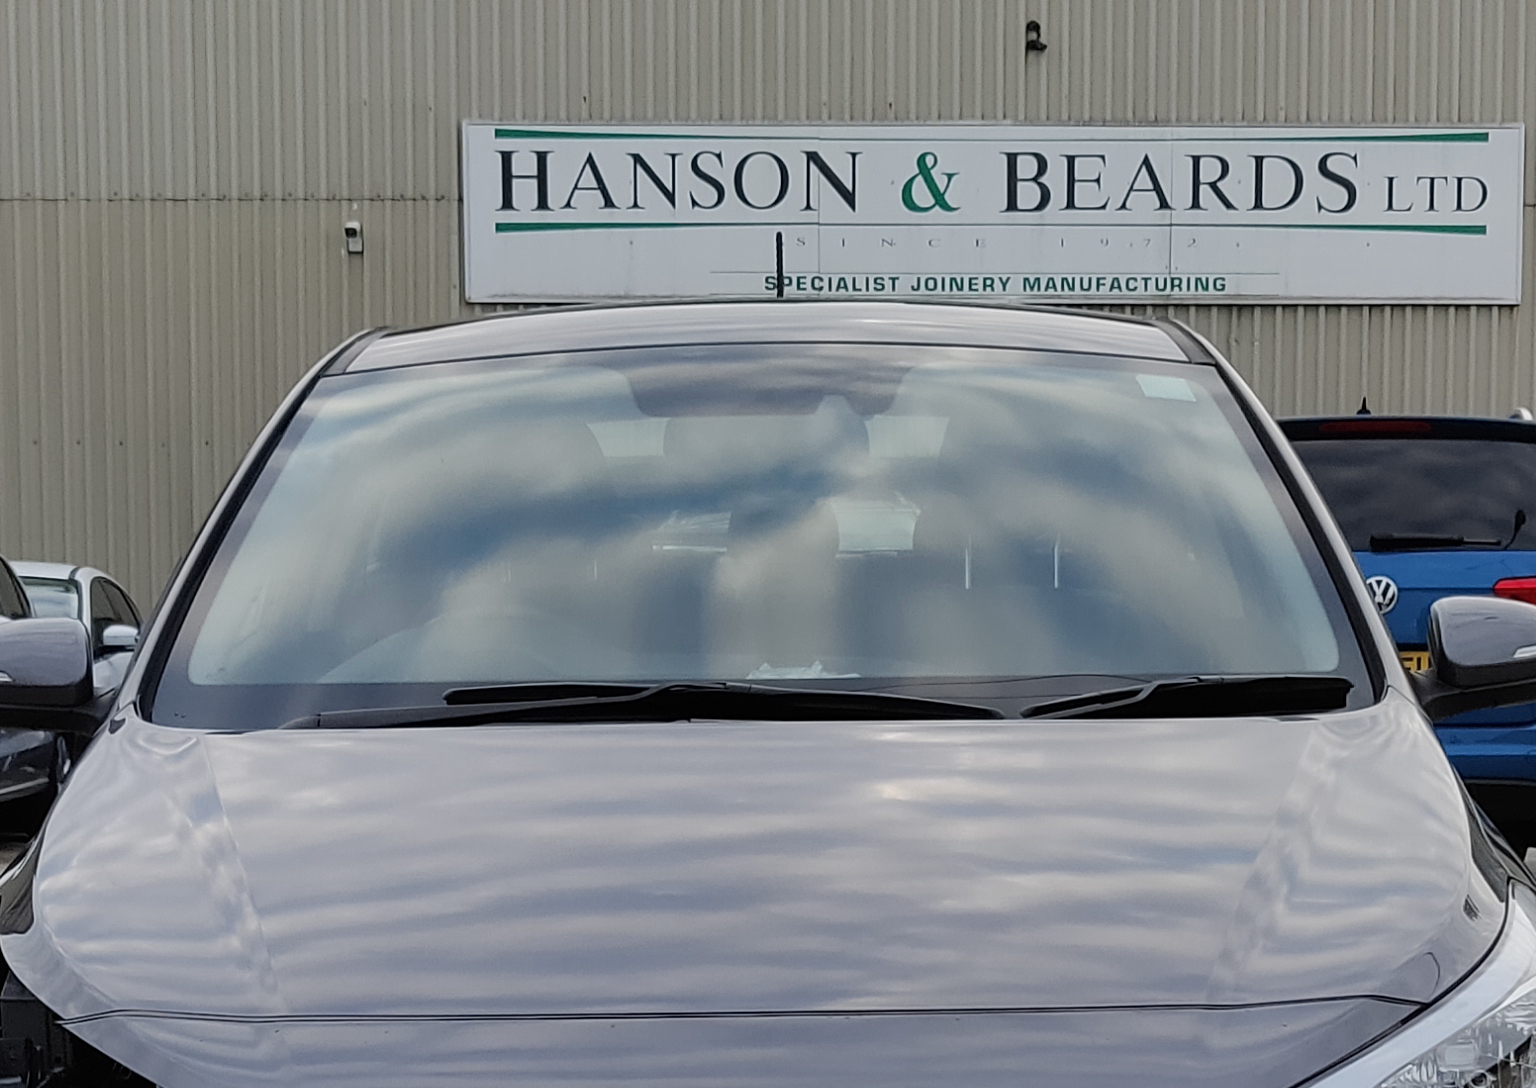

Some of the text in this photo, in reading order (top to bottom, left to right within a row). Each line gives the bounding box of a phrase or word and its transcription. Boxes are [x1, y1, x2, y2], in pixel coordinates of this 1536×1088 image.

[494, 149, 1489, 214] HANSON & BEARDS LTD
[764, 275, 1228, 293] SPECIALIST JOINERY MANUFACTURING
